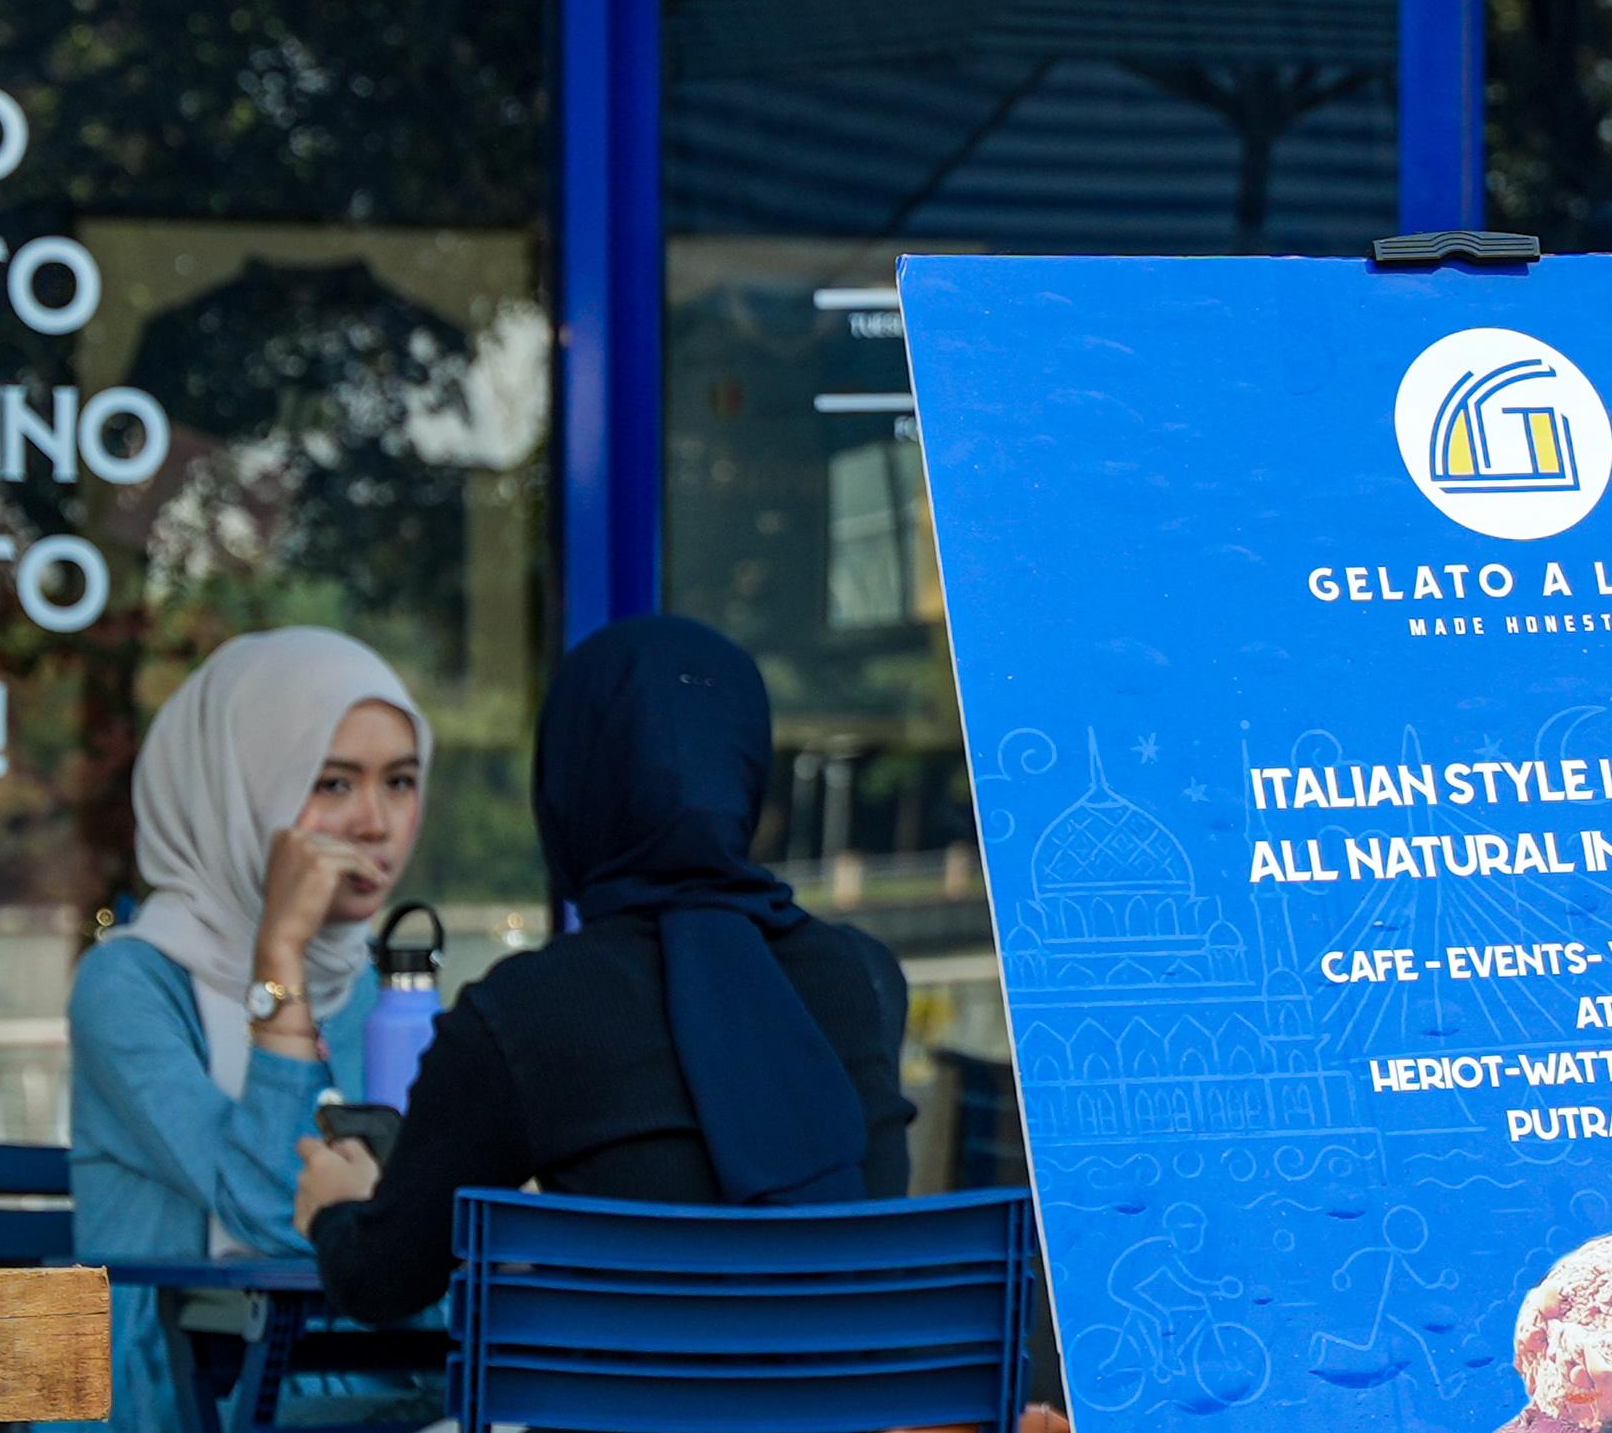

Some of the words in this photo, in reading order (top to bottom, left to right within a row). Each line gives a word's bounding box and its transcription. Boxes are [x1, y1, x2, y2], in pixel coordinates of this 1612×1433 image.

[1308, 563, 1515, 602] GELATO
[1542, 562, 1573, 597] A
[1408, 617, 1485, 637] MADE
[1250, 764, 1438, 810] ITALIAN
[1444, 759, 1594, 805] STYLE
[1249, 839, 1339, 883] ALL
[1345, 832, 1576, 880] NATURAL
[1321, 949, 1420, 984] CAFE
